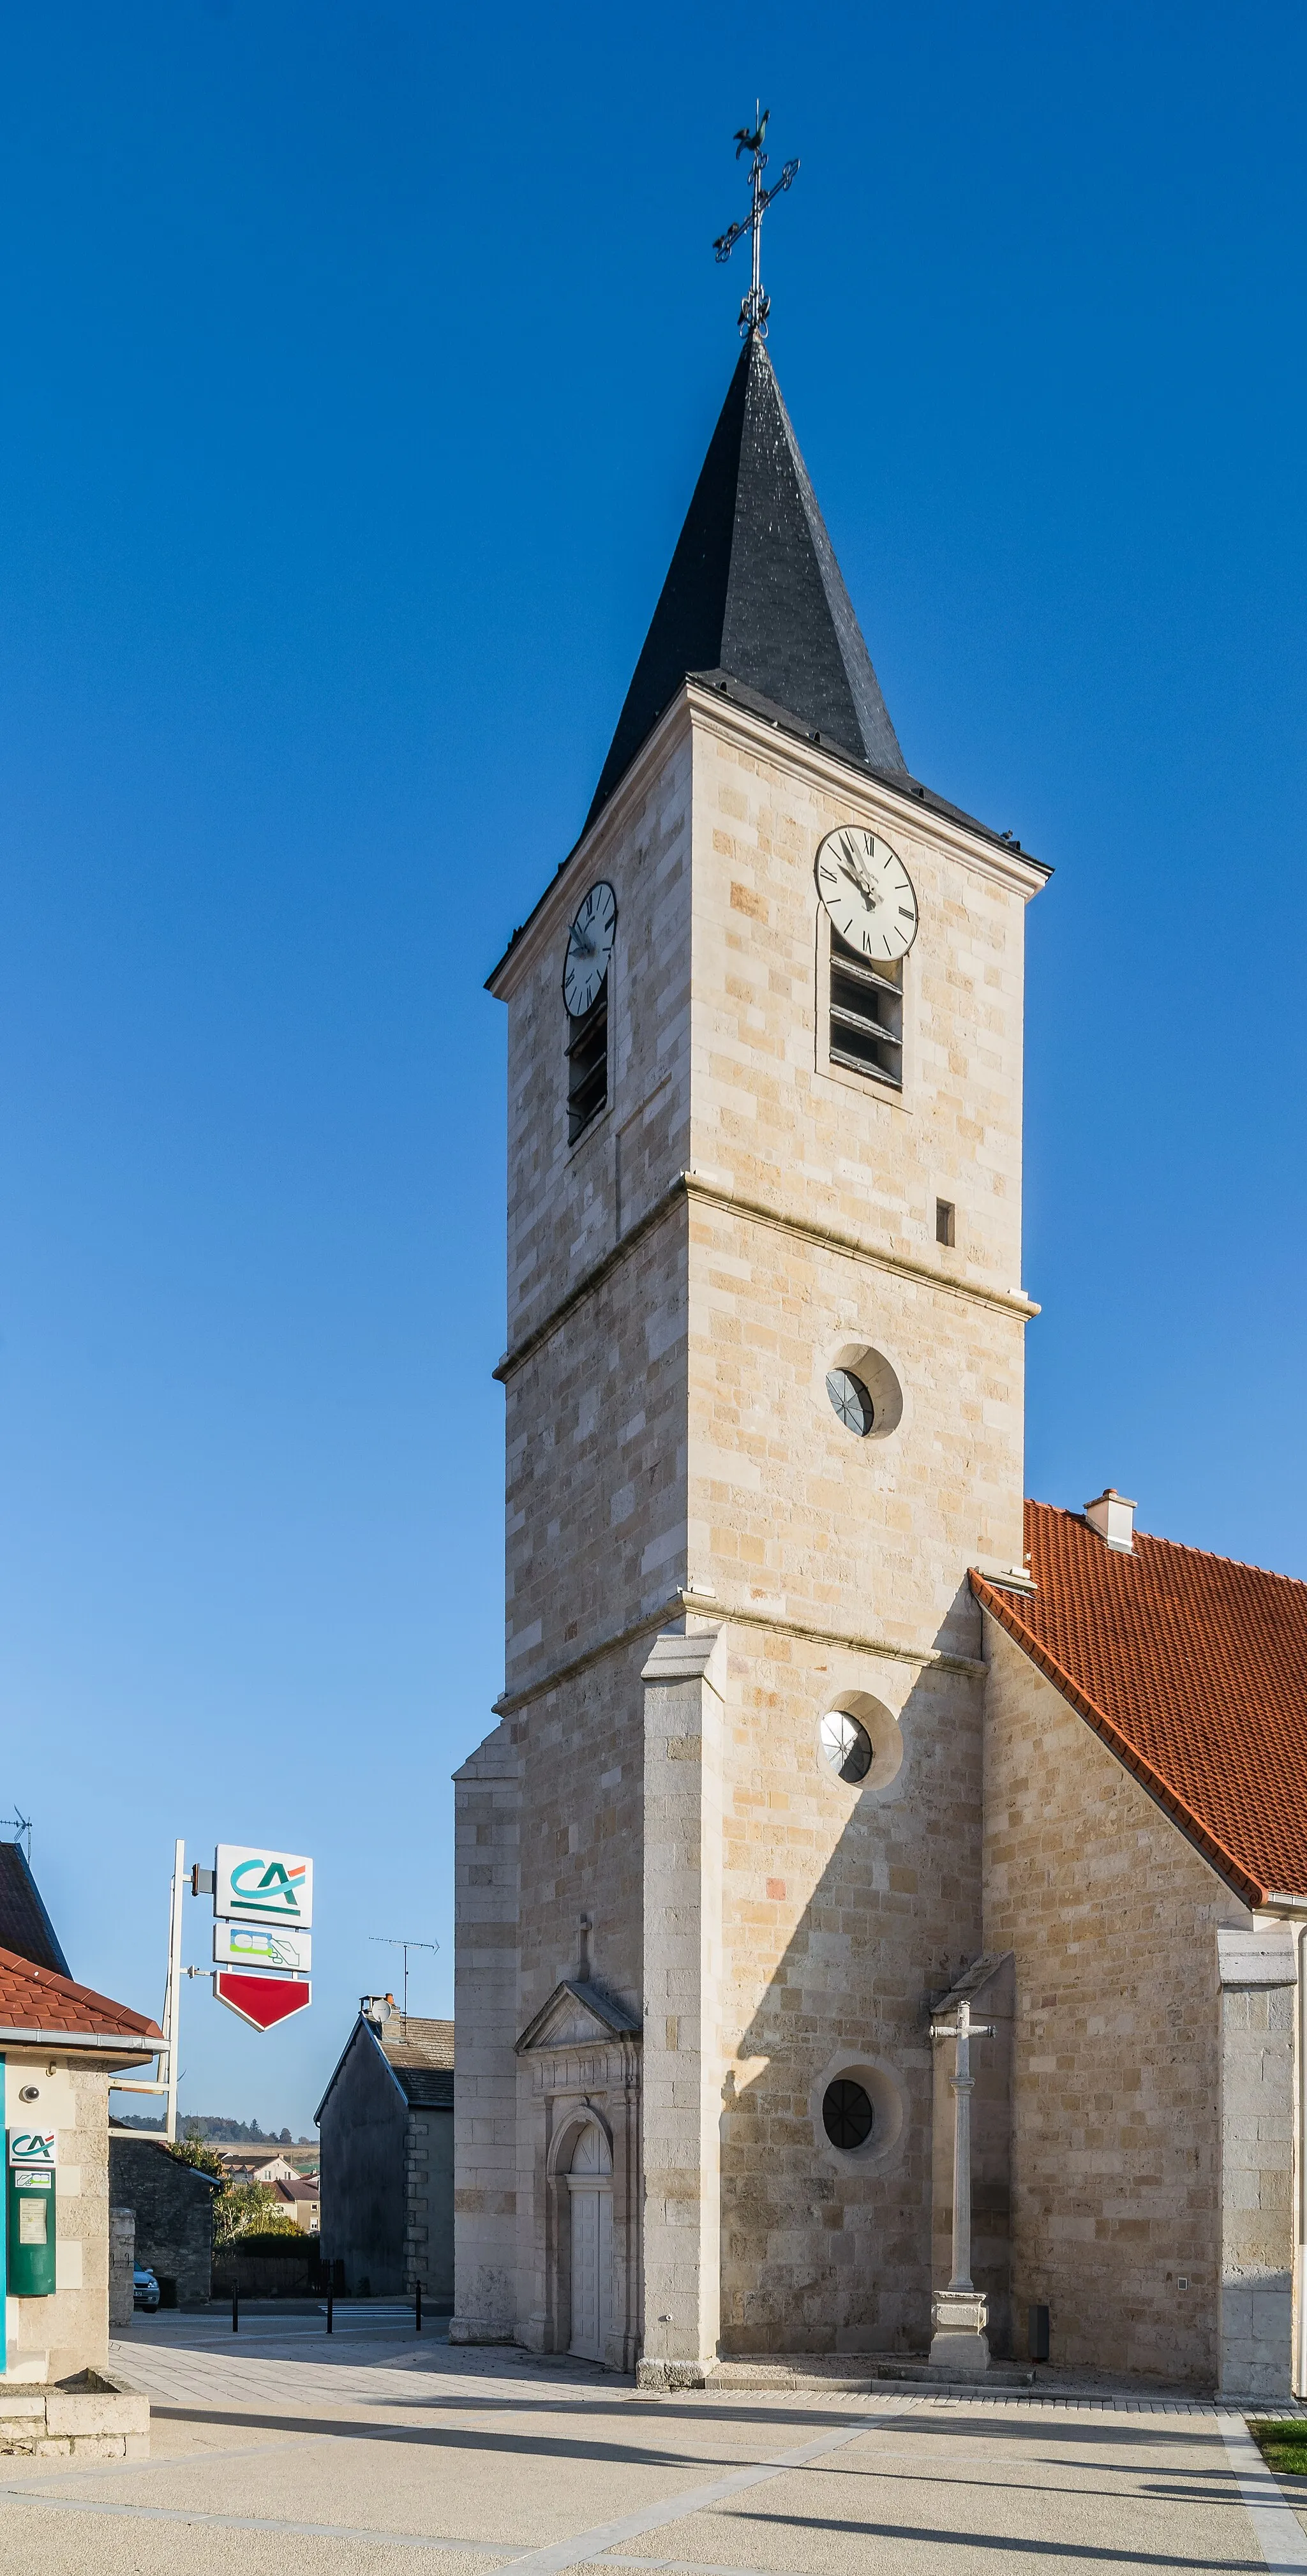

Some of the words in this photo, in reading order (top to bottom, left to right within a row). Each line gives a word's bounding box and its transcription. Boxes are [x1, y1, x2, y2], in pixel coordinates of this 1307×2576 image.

[863, 833, 874, 858] XII
[820, 865, 837, 884] IX
[230, 1859, 306, 1905] CA
[11, 2134, 54, 2157] CA
